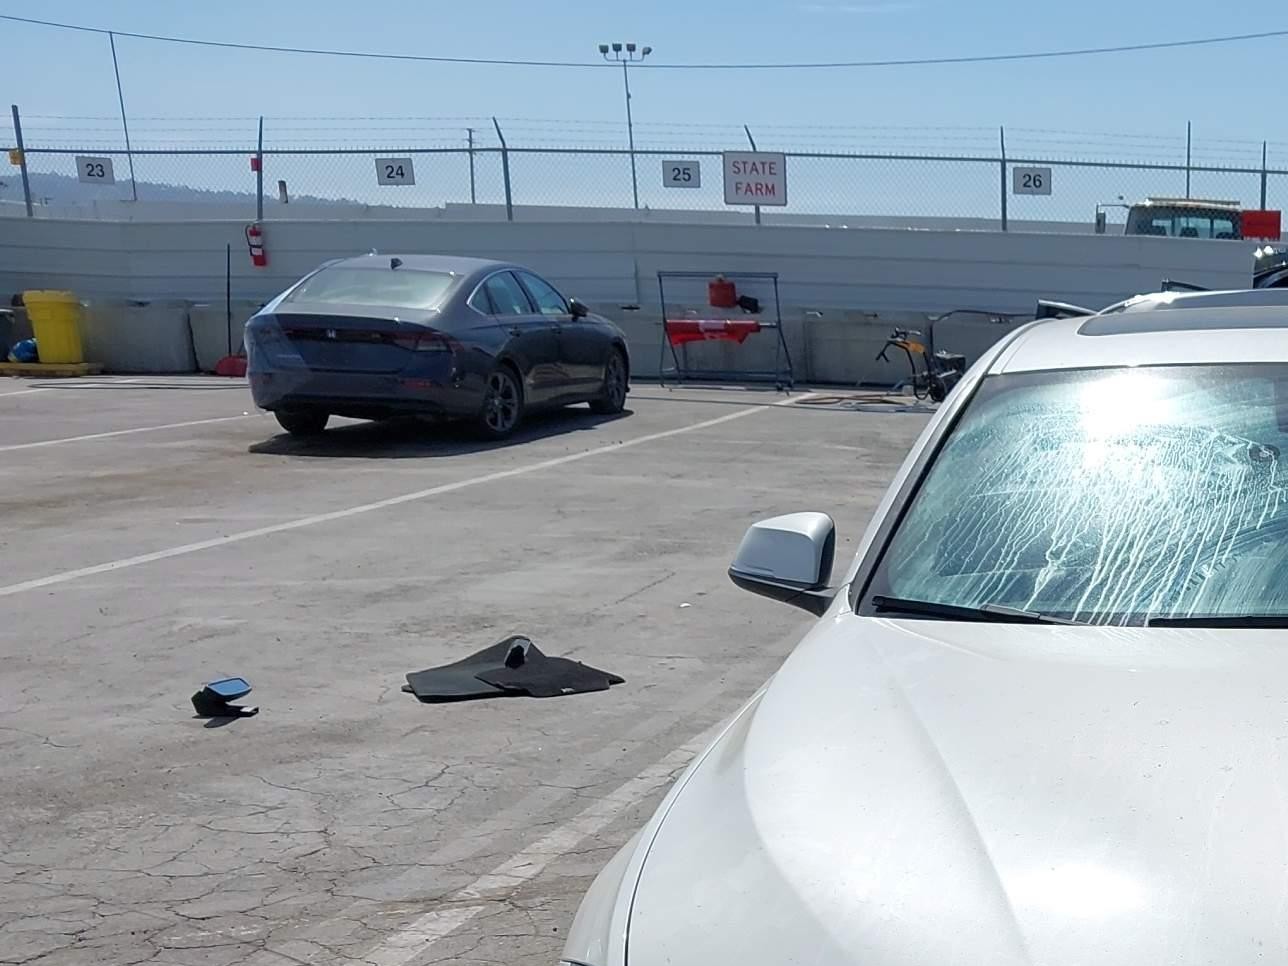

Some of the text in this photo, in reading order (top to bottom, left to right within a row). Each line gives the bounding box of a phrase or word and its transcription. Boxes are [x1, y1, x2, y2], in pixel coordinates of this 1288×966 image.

[86, 163, 105, 178] 23
[385, 164, 405, 179] 24
[672, 167, 692, 182] 25
[732, 161, 777, 176] STATE
[1022, 173, 1042, 188] 26
[735, 182, 776, 196] FARM
